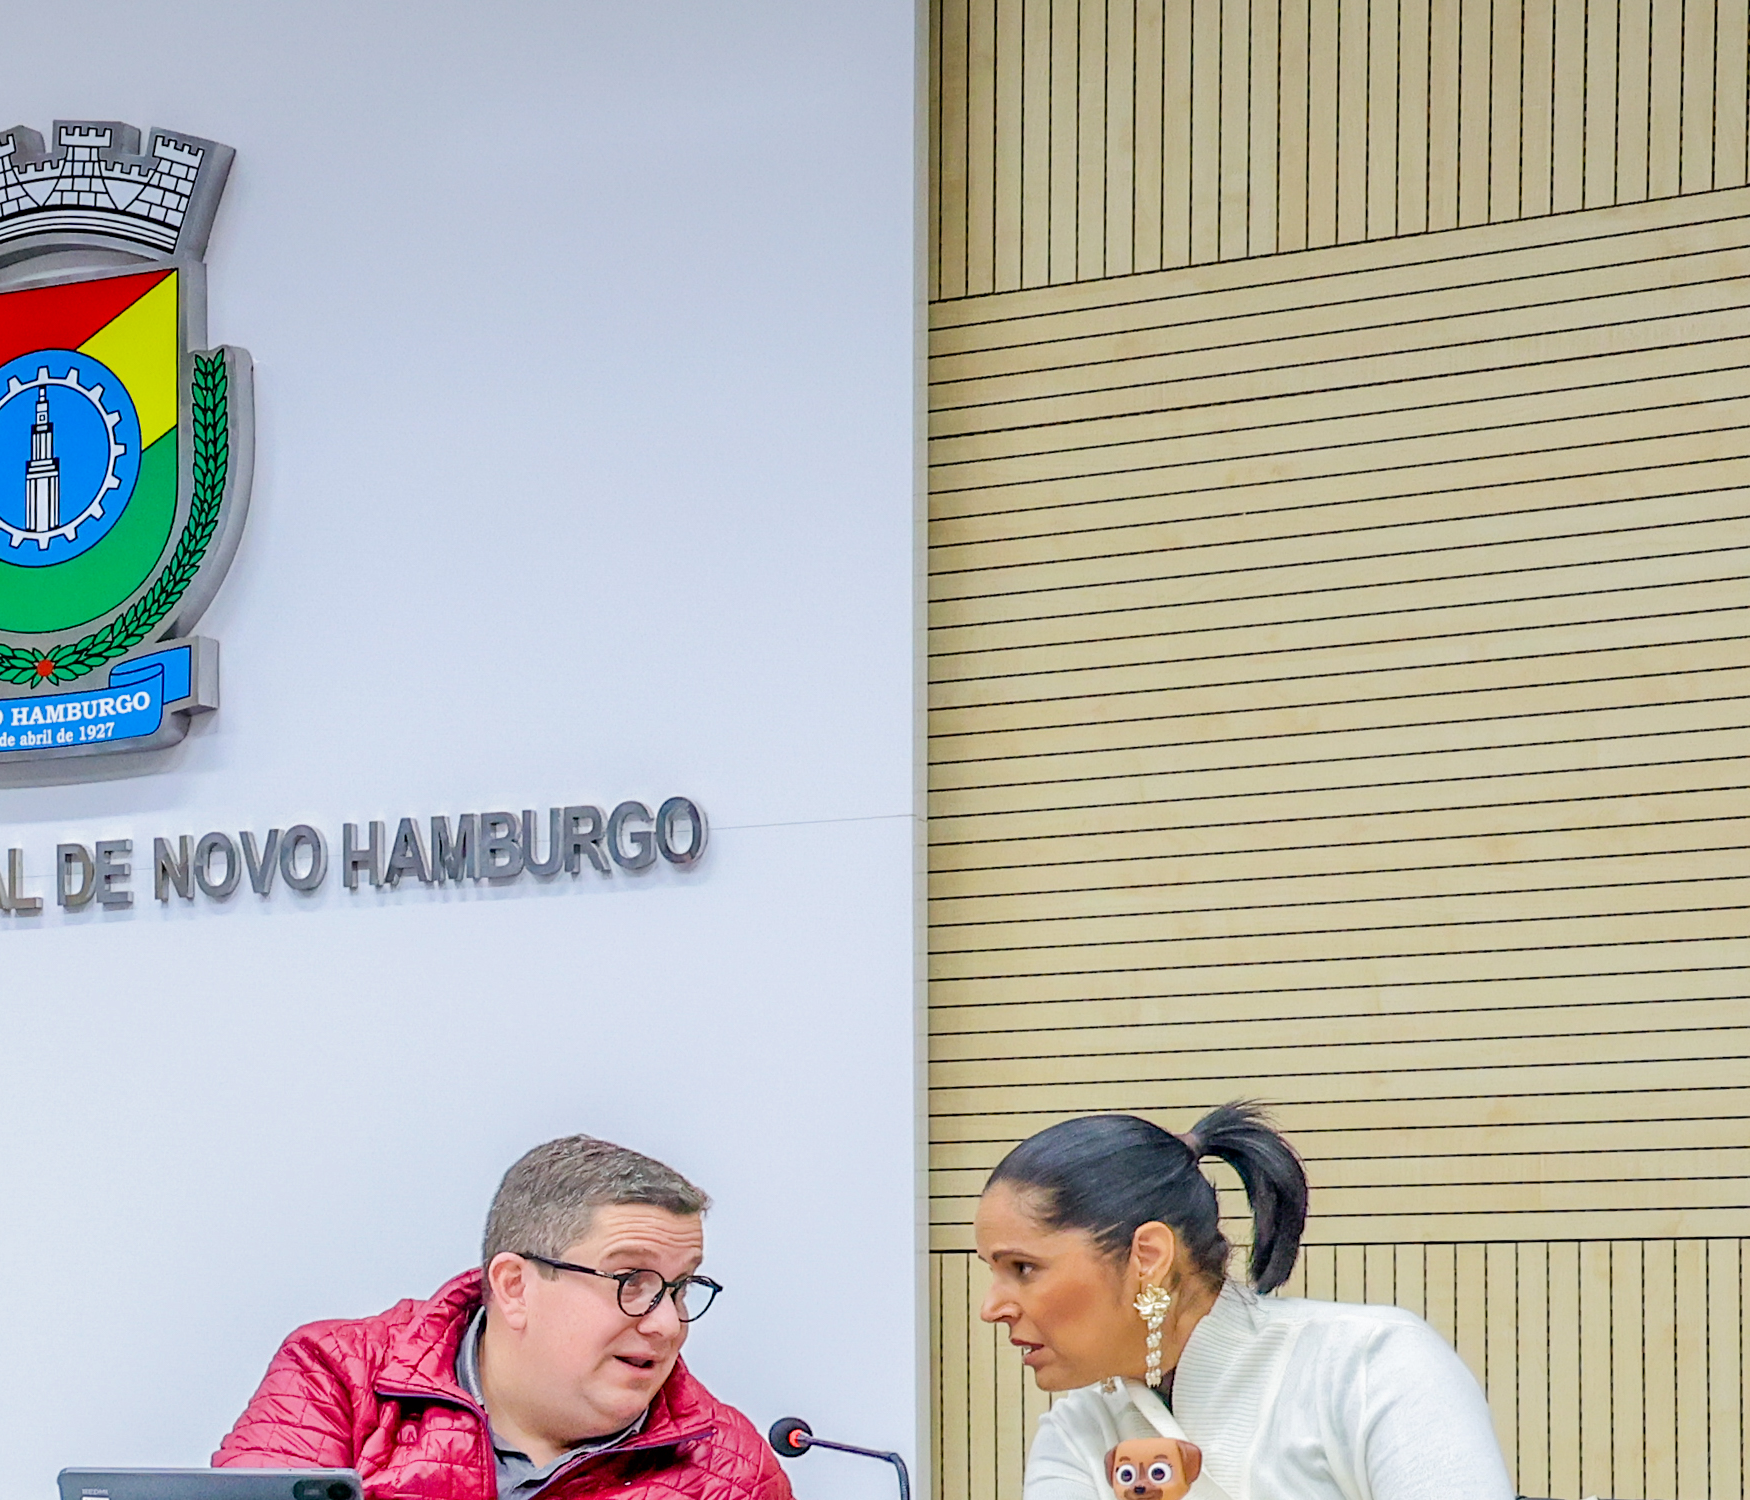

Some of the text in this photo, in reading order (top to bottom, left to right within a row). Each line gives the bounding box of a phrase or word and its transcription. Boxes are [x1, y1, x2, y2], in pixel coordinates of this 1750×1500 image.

[11, 691, 151, 726] HAMBURGO
[19, 727, 52, 746] abril
[56, 727, 74, 743] de
[79, 721, 115, 741] 1927
[56, 838, 133, 910] DE
[153, 824, 328, 902] NOVO
[342, 796, 709, 888] HAMBURGO
